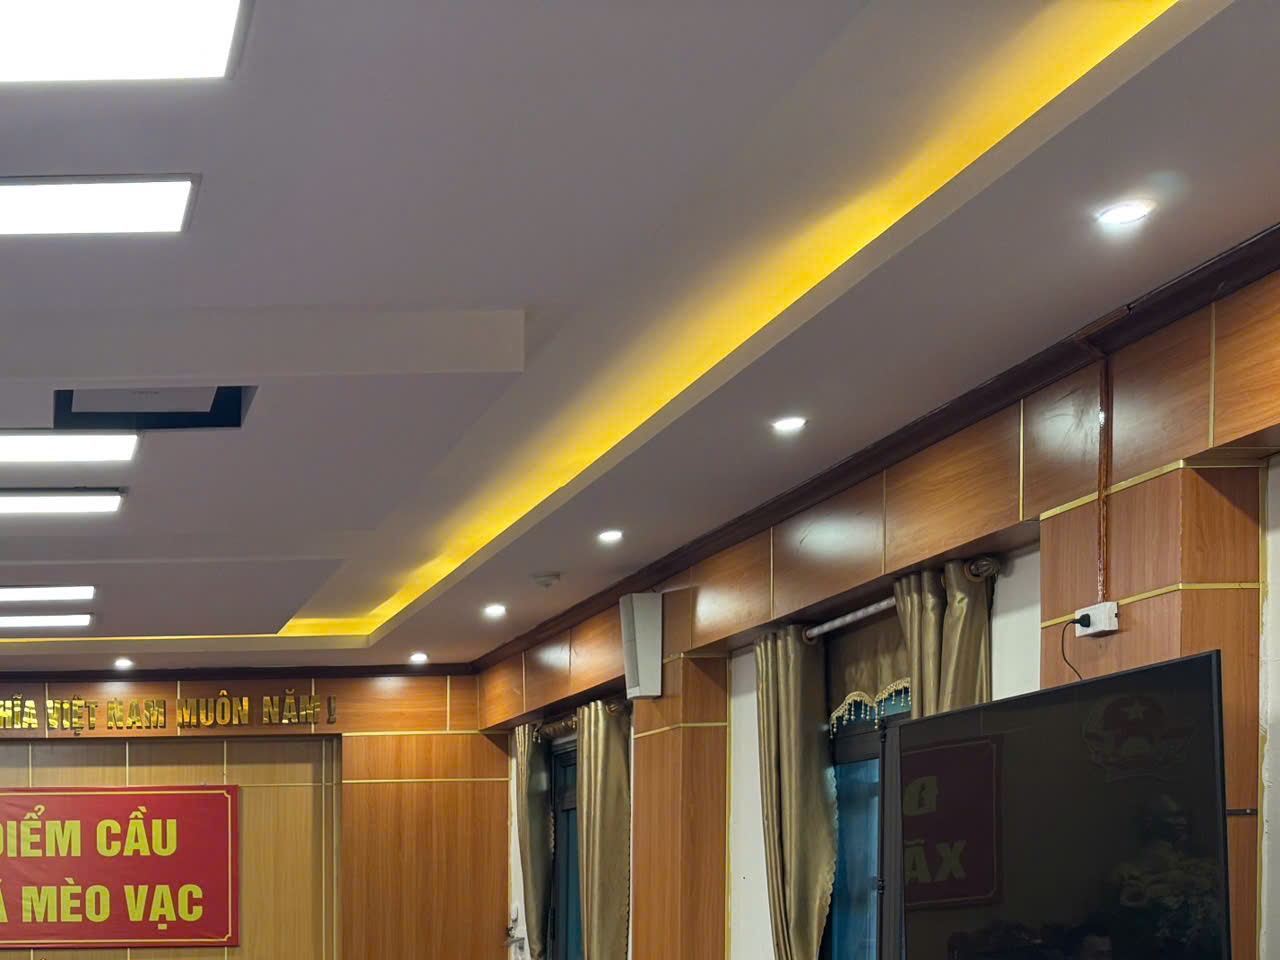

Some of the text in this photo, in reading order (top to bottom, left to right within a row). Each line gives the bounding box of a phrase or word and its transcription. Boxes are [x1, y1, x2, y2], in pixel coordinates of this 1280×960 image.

[46, 694, 98, 736] VIỆT
[106, 698, 167, 730] NAM
[176, 689, 249, 728] MUÔN
[261, 688, 320, 725] NĂM
[96, 805, 177, 857] CẦU
[21, 877, 110, 923] MÈO
[124, 884, 203, 930] VẠC
